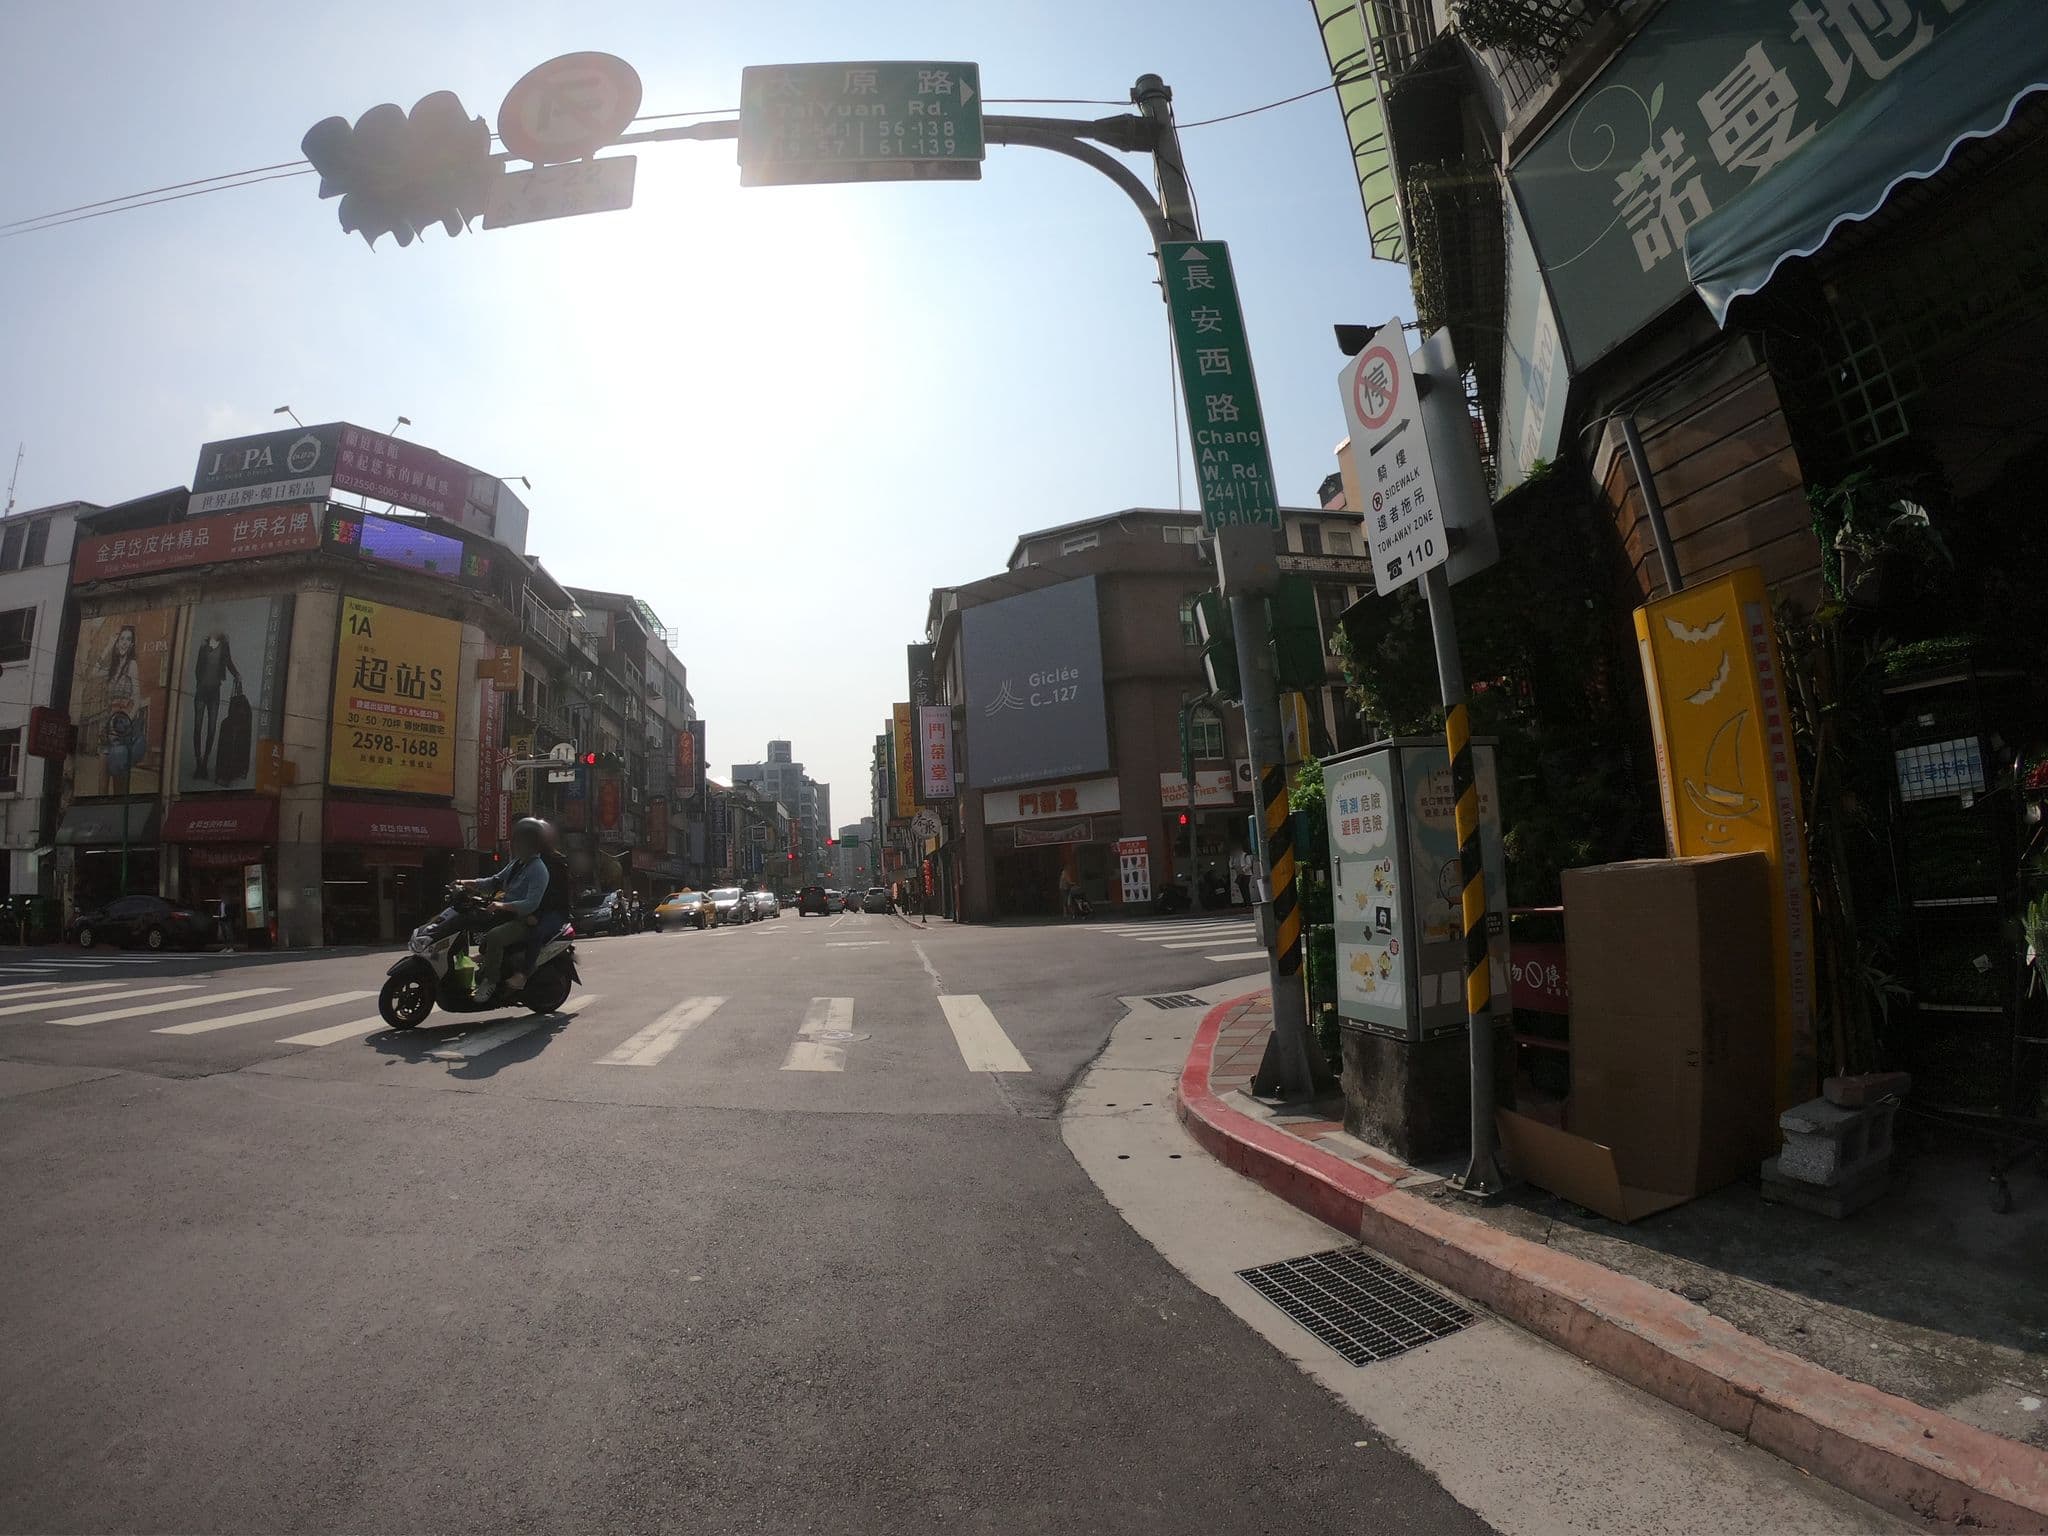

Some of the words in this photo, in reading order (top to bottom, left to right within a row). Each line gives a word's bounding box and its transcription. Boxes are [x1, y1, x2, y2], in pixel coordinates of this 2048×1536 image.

[769, 69, 954, 97] 太原路
[907, 100, 949, 117] Rd.
[879, 121, 955, 137] 56-138
[1612, 0, 1966, 272] 諾曼地
[879, 140, 956, 156] 61-139
[1182, 265, 1240, 424] 長安西路
[1363, 361, 1387, 416] 停
[1196, 429, 1261, 447] Chang
[1202, 448, 1229, 462] An
[1377, 449, 1407, 483] 騎樓
[1203, 465, 1224, 480] W.
[1232, 463, 1262, 478] Rd.
[1384, 467, 1421, 500] SIDEWALK
[1206, 483, 1234, 501] 244
[1242, 482, 1271, 499] 171
[1377, 487, 1425, 532] 違者拖吊
[232, 513, 309, 543] 世界名牌
[1377, 520, 1412, 555] TOW-AWAY
[1413, 508, 1434, 530] ZONE
[96, 528, 210, 563] 金昇岱皮件精品
[1407, 538, 1434, 567] 110
[349, 614, 373, 638] 1A
[1029, 667, 1080, 687] Giclée
[1030, 685, 1079, 707] C_127
[348, 713, 360, 723] 30
[366, 715, 377, 726] 50
[352, 731, 438, 757] 2598-1688
